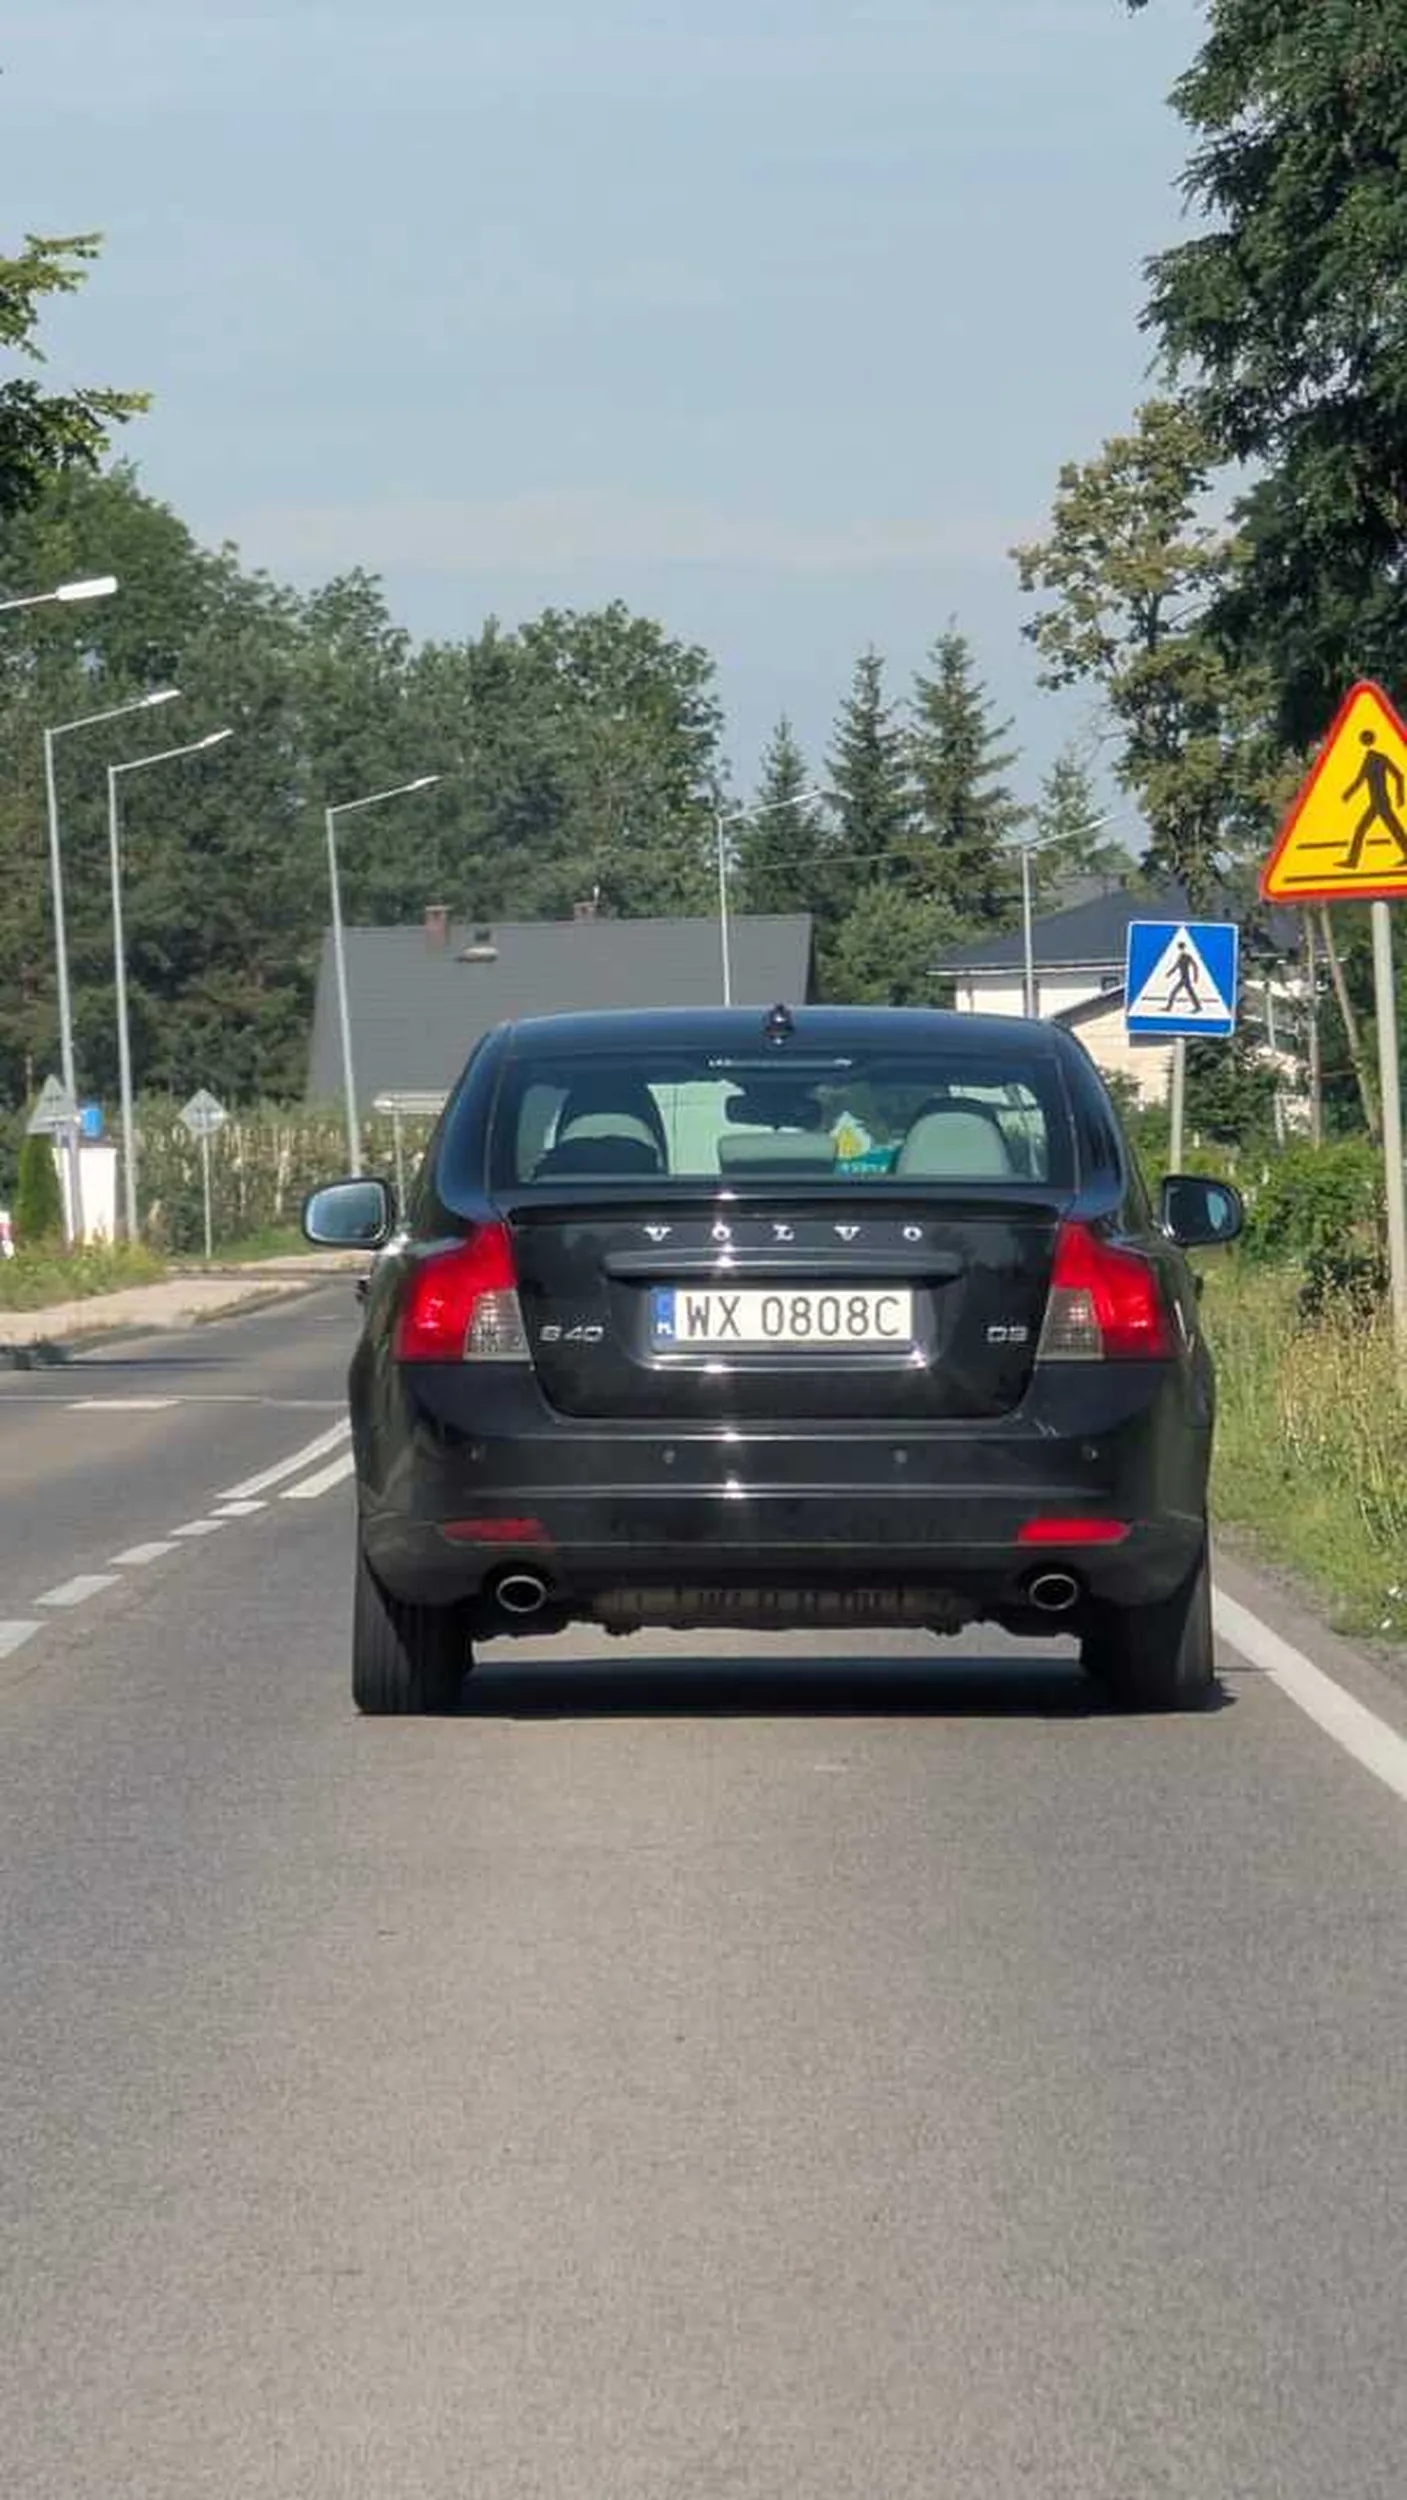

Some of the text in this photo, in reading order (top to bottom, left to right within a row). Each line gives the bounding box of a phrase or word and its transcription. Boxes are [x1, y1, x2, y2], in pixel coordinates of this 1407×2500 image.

[643, 1222, 923, 1242] VOLVO
[686, 1296, 900, 1337] WX 0808C
